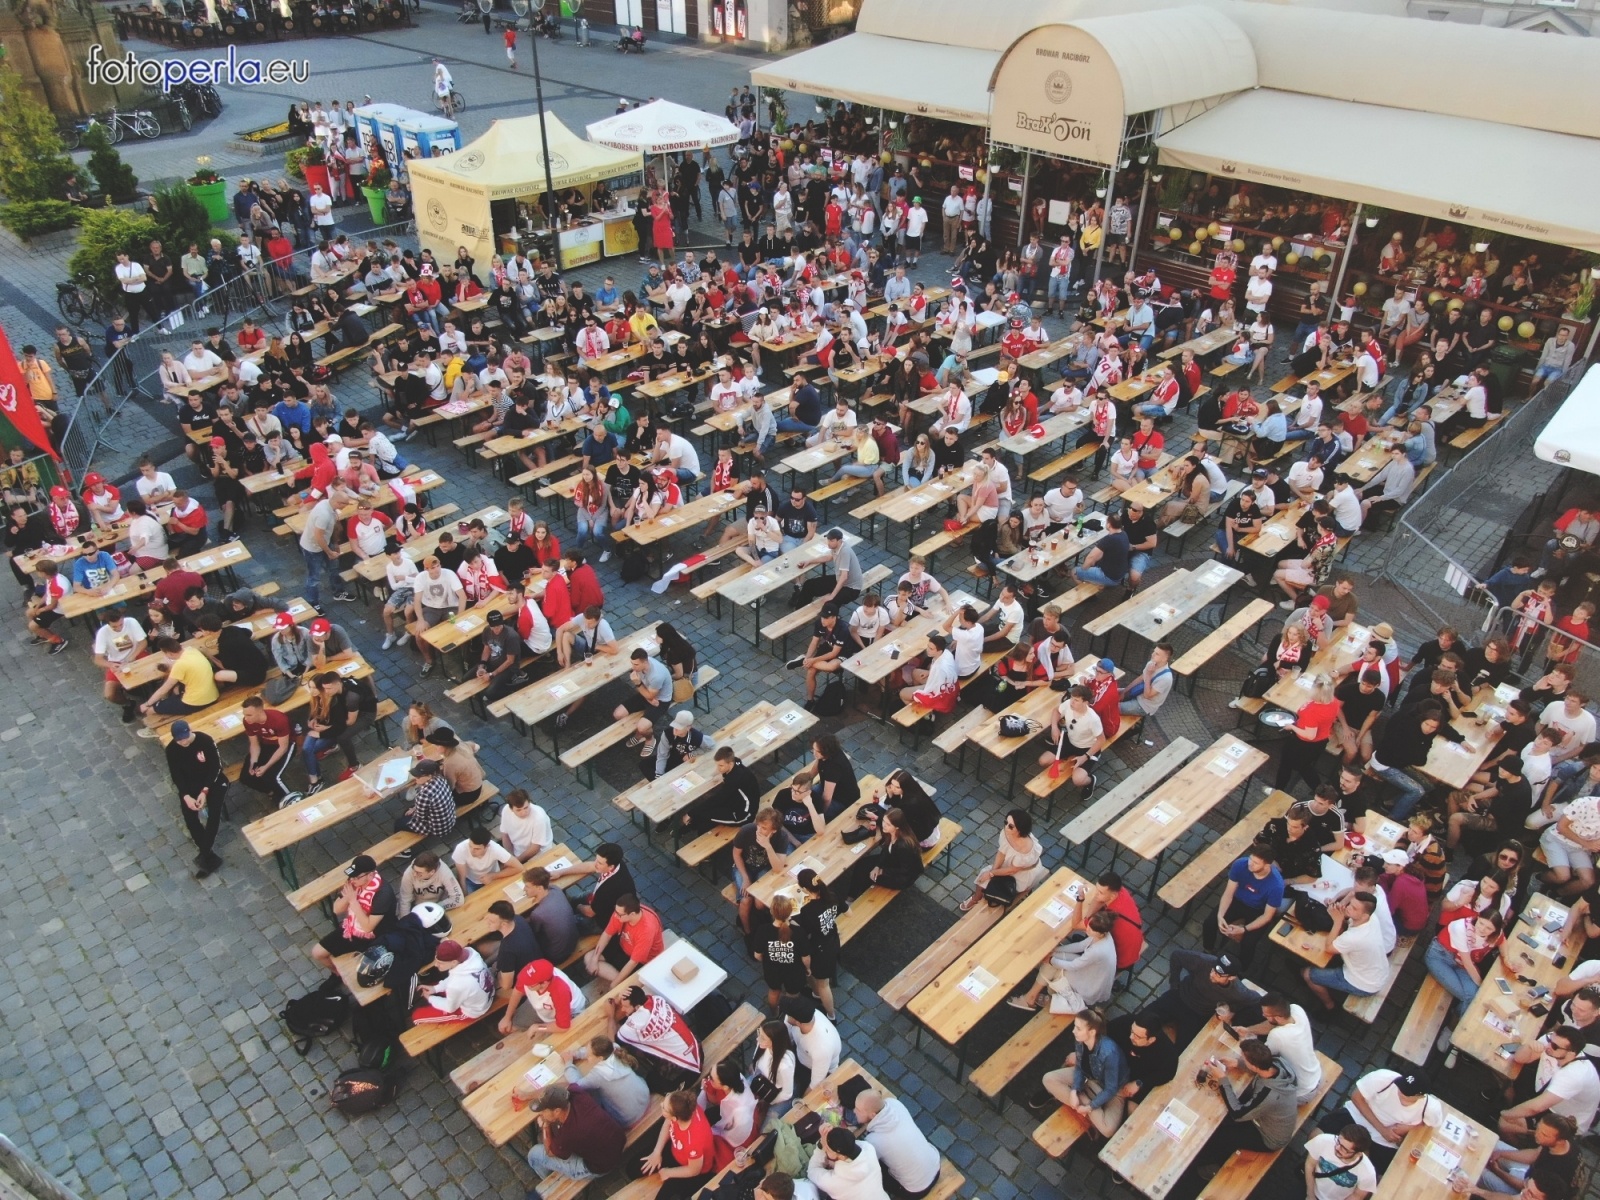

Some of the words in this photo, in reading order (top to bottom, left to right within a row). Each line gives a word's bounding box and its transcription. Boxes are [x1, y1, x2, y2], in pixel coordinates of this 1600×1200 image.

[1035, 48, 1060, 59] BROWAR
[651, 139, 701, 152] RACIBORSKIE
[785, 713, 797, 722] 15
[1231, 746, 1243, 755] 25
[1382, 826, 1397, 836] 24
[817, 905, 838, 922] ZERO
[1548, 910, 1565, 921] 23
[768, 941, 794, 949] ZERO
[768, 951, 795, 959] ZERO
[1445, 1120, 1462, 1136] 11
